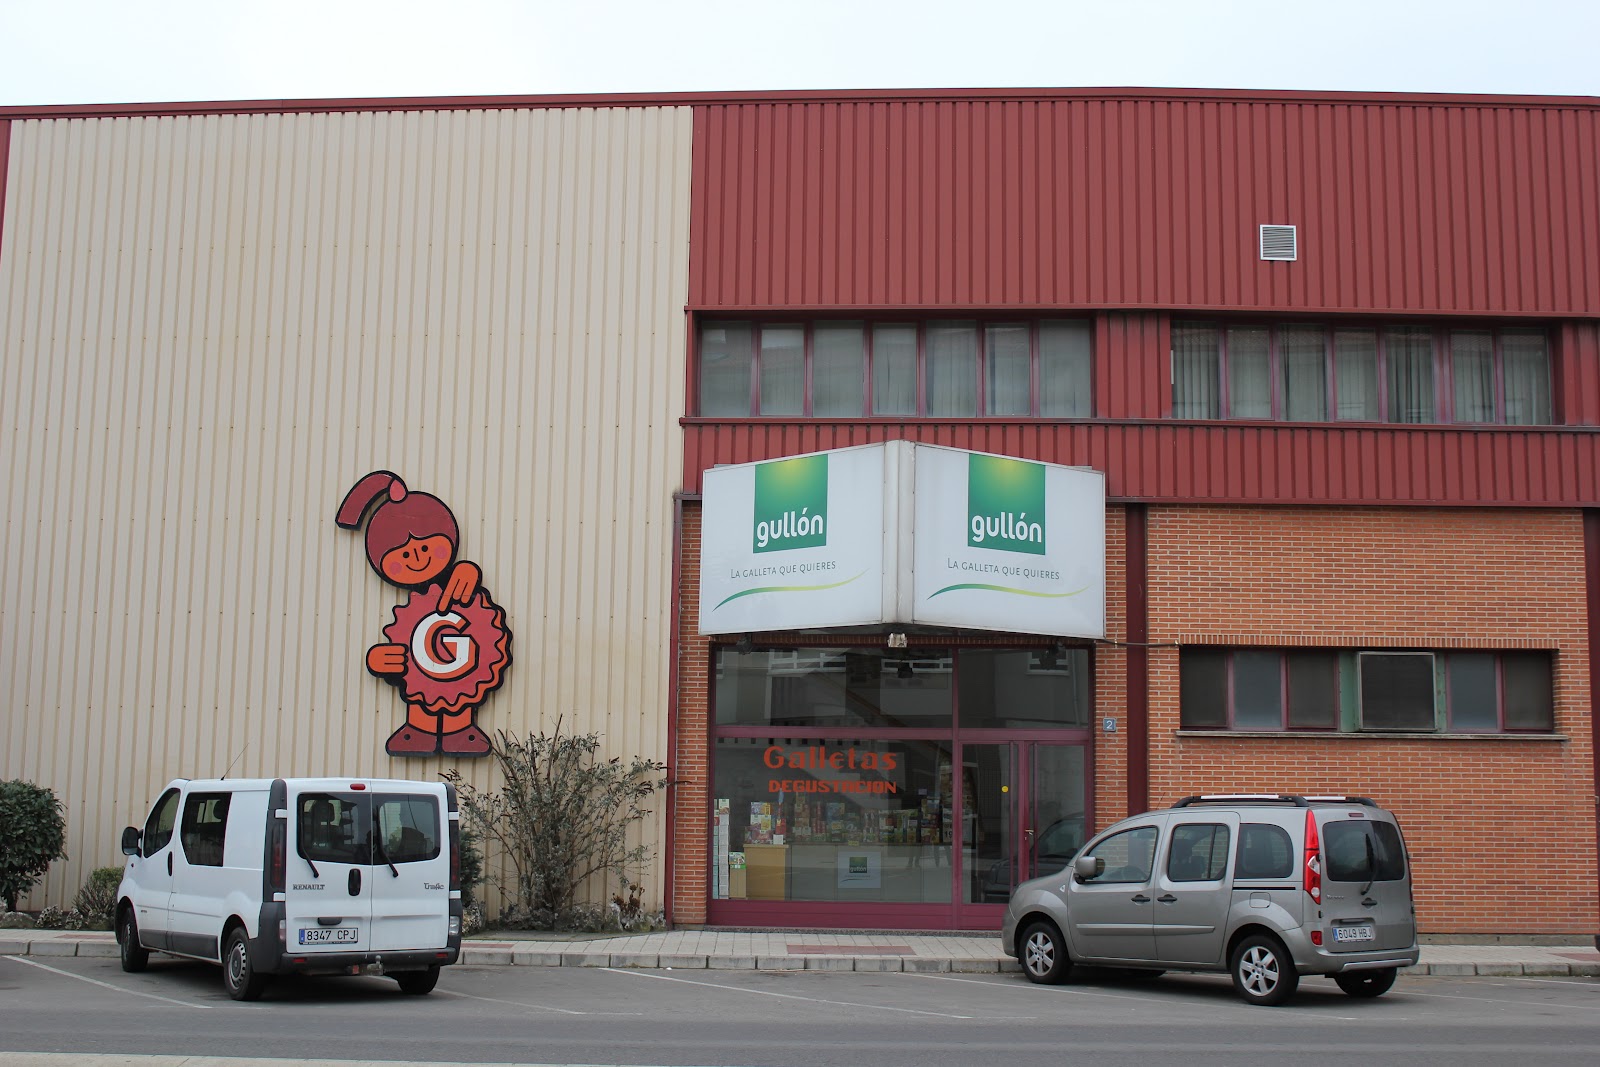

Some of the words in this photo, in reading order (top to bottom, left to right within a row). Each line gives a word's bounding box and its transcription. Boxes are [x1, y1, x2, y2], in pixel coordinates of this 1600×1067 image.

[756, 507, 823, 548] gullón
[971, 511, 1042, 543] gullón
[742, 566, 777, 578] GALLETA
[779, 564, 797, 576] QUE
[799, 560, 836, 574] QUIERES
[961, 561, 999, 574] GALLETA
[1001, 566, 1021, 577] QUE
[1023, 568, 1060, 580] QUIERES
[410, 610, 480, 682] G
[1106, 720, 1113, 729] 2
[763, 745, 897, 770] Galletas
[768, 779, 897, 794] DEGUSTACION
[292, 883, 325, 891] RENAULT
[306, 930, 332, 941] 8347
[337, 929, 356, 940] CPJ
[1338, 928, 1357, 939] 6049
[1359, 928, 1372, 938] HBJ
